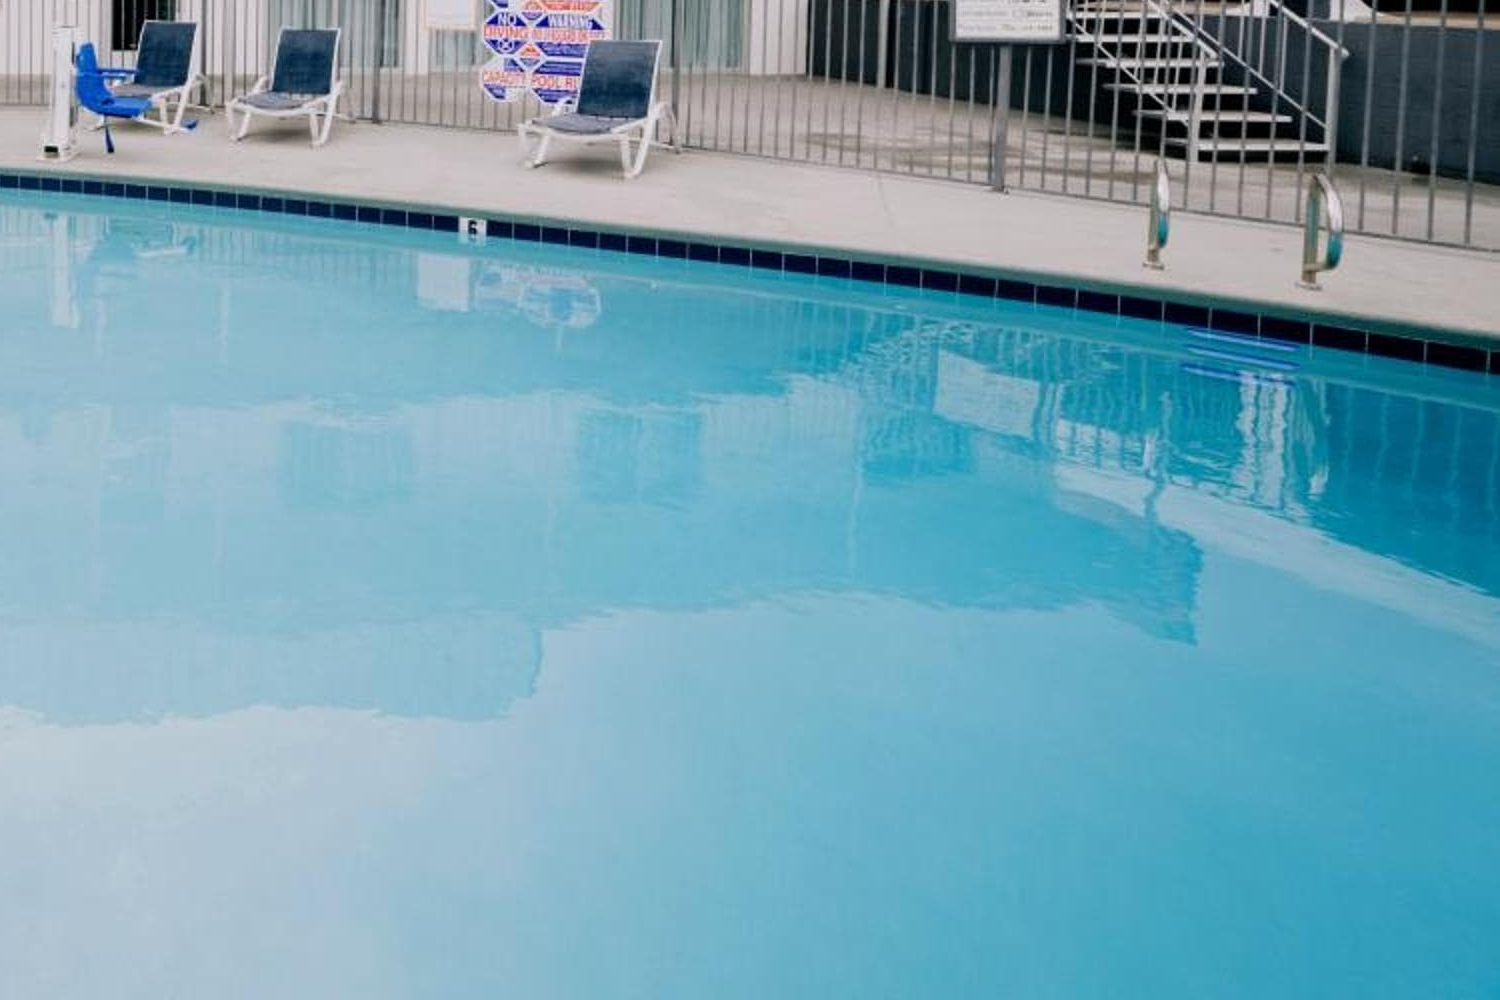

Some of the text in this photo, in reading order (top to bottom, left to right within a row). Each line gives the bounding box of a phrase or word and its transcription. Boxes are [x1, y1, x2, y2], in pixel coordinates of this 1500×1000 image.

[498, 13, 517, 26] NO
[484, 26, 528, 39] DIVING
[532, 75, 562, 88] POOL
